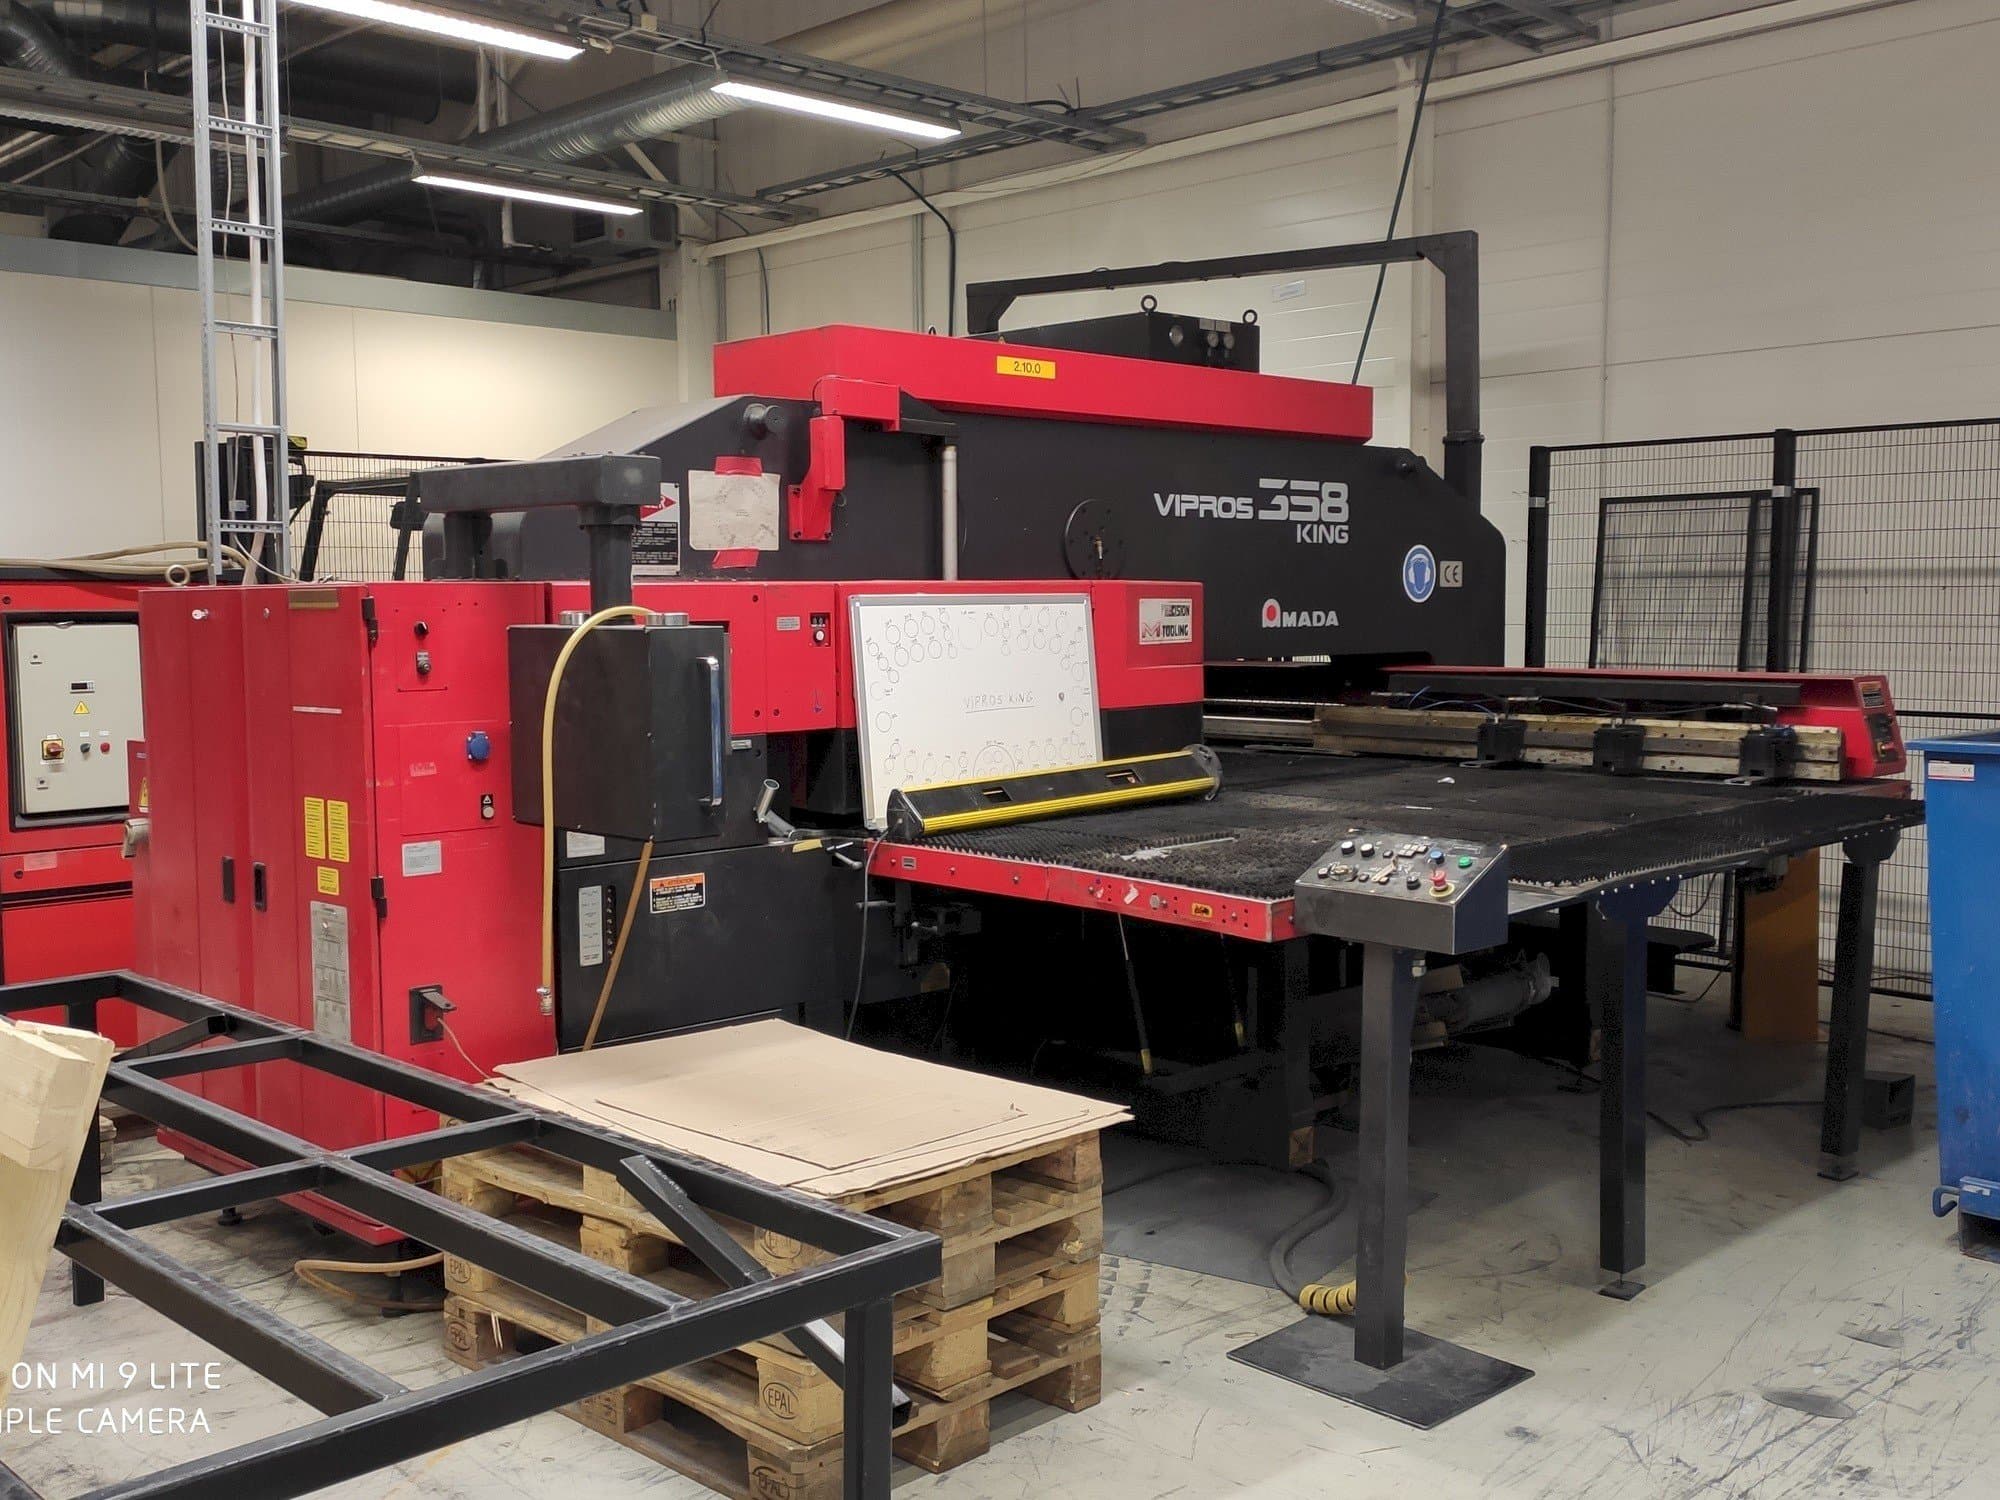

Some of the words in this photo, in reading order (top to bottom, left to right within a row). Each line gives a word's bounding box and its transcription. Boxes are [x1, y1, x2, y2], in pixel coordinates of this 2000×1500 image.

[1013, 361, 1041, 374] 2.10.0
[1153, 492, 1253, 520] VIPROS
[1257, 477, 1350, 523] 358
[1296, 523, 1350, 545] KING
[1261, 597, 1340, 628] AMADA
[1162, 623, 1189, 638] TOOLING
[767, 1387, 794, 1415] EPAL
